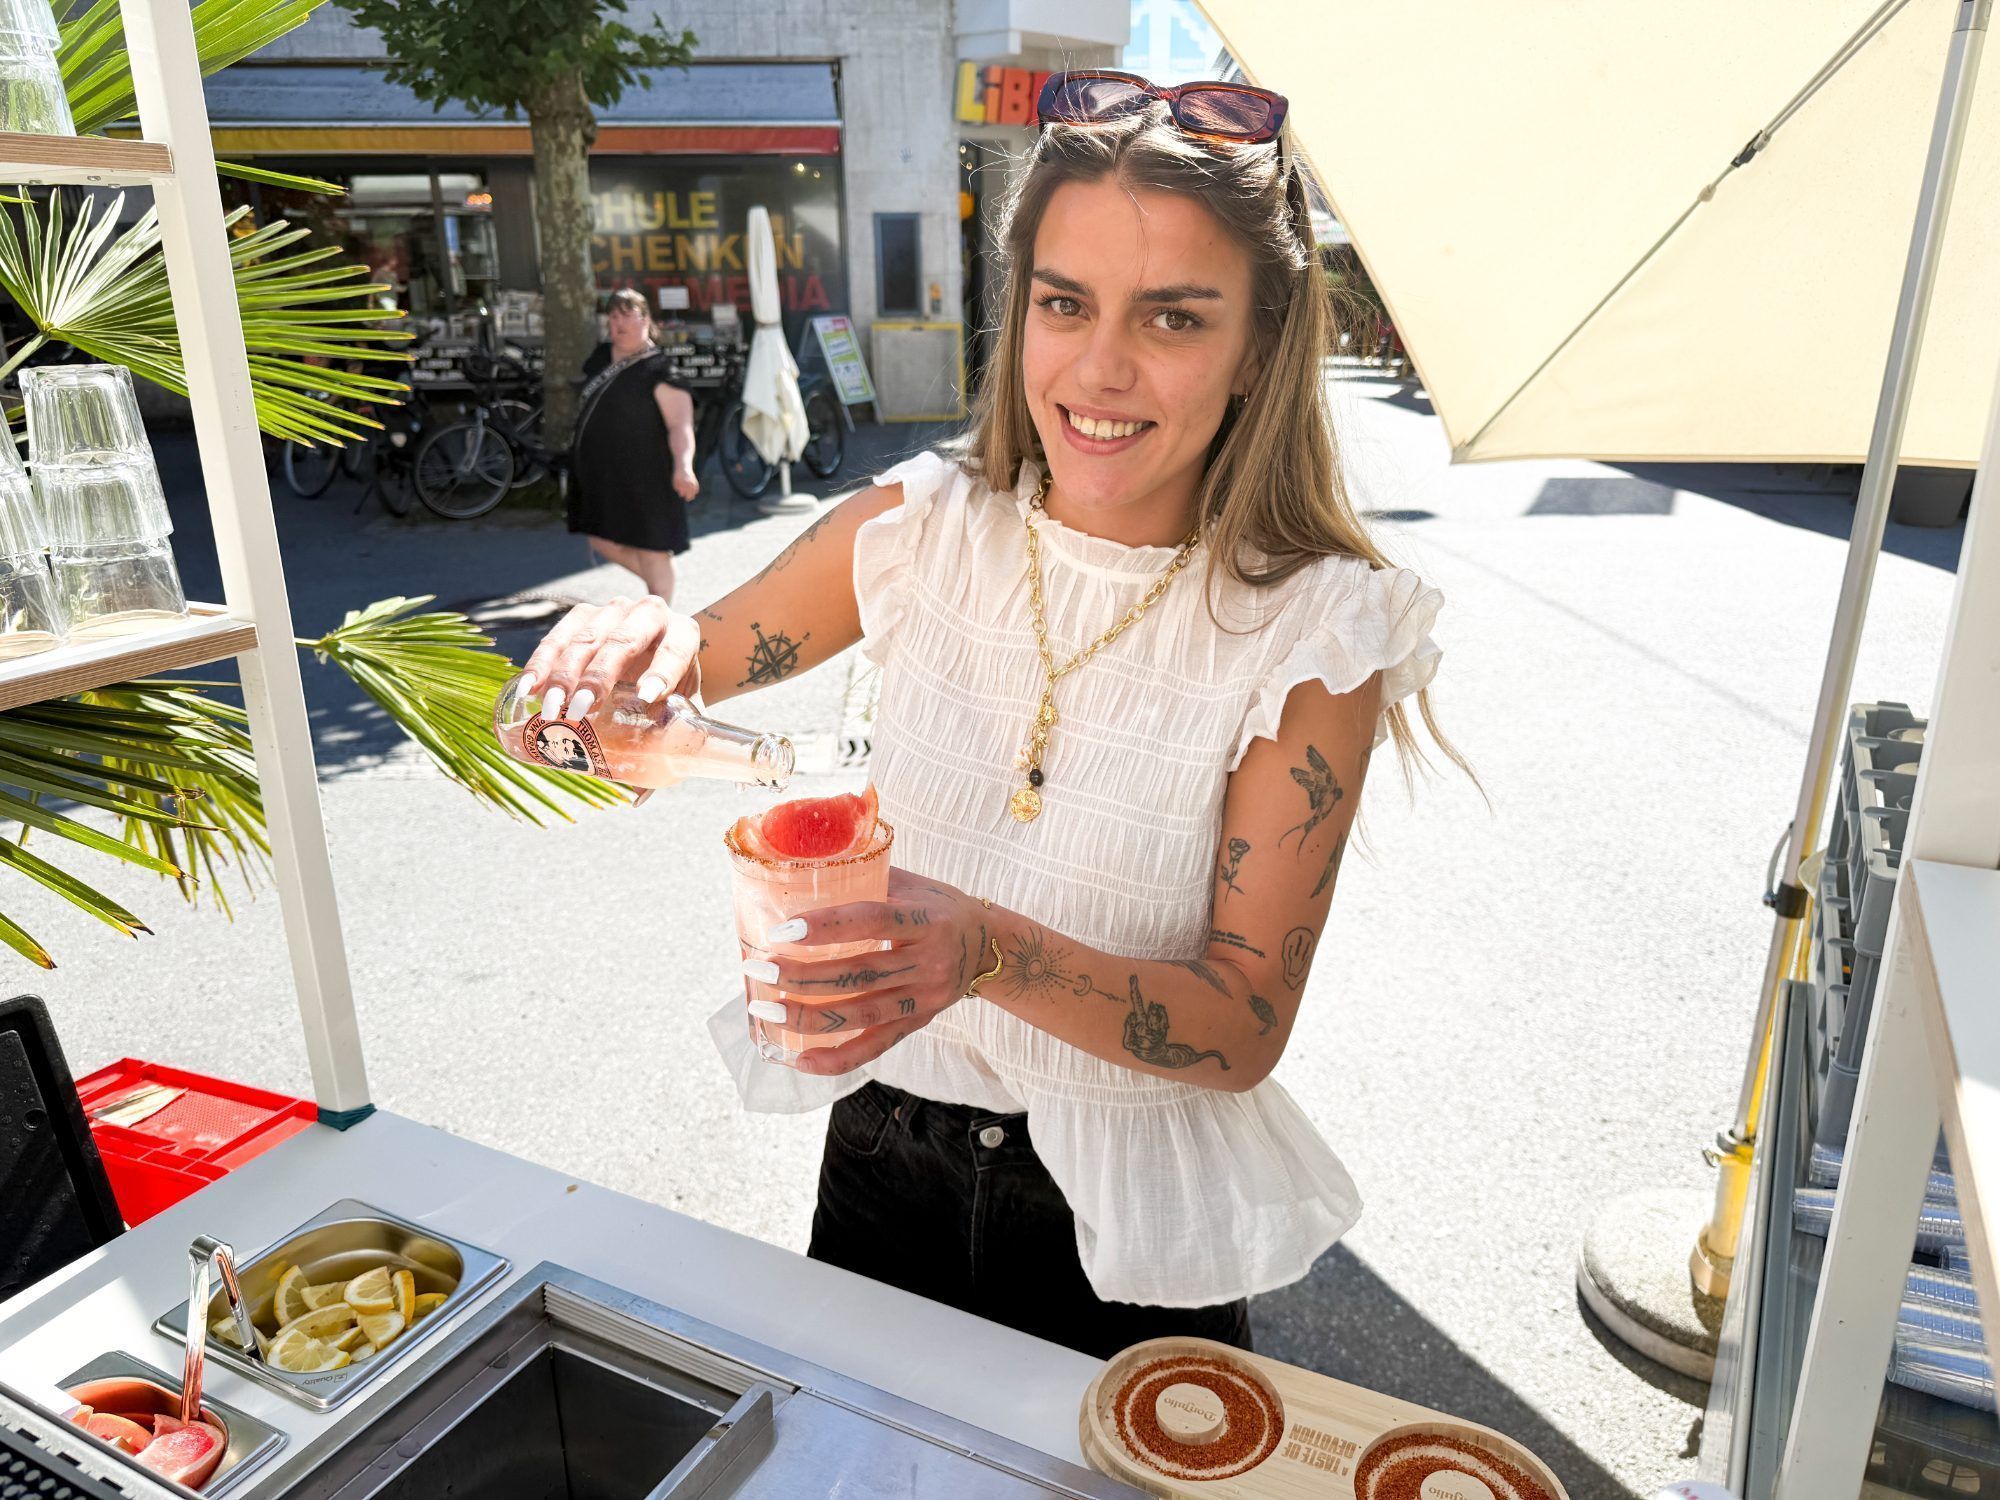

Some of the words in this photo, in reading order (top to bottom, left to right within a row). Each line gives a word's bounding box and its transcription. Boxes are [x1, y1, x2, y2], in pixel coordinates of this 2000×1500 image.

[576, 720, 604, 765] THOMAS
[1281, 1441, 1302, 1461] OF
[1289, 1423, 1357, 1459] DEVOTION
[1301, 1447, 1341, 1475] TASTE
